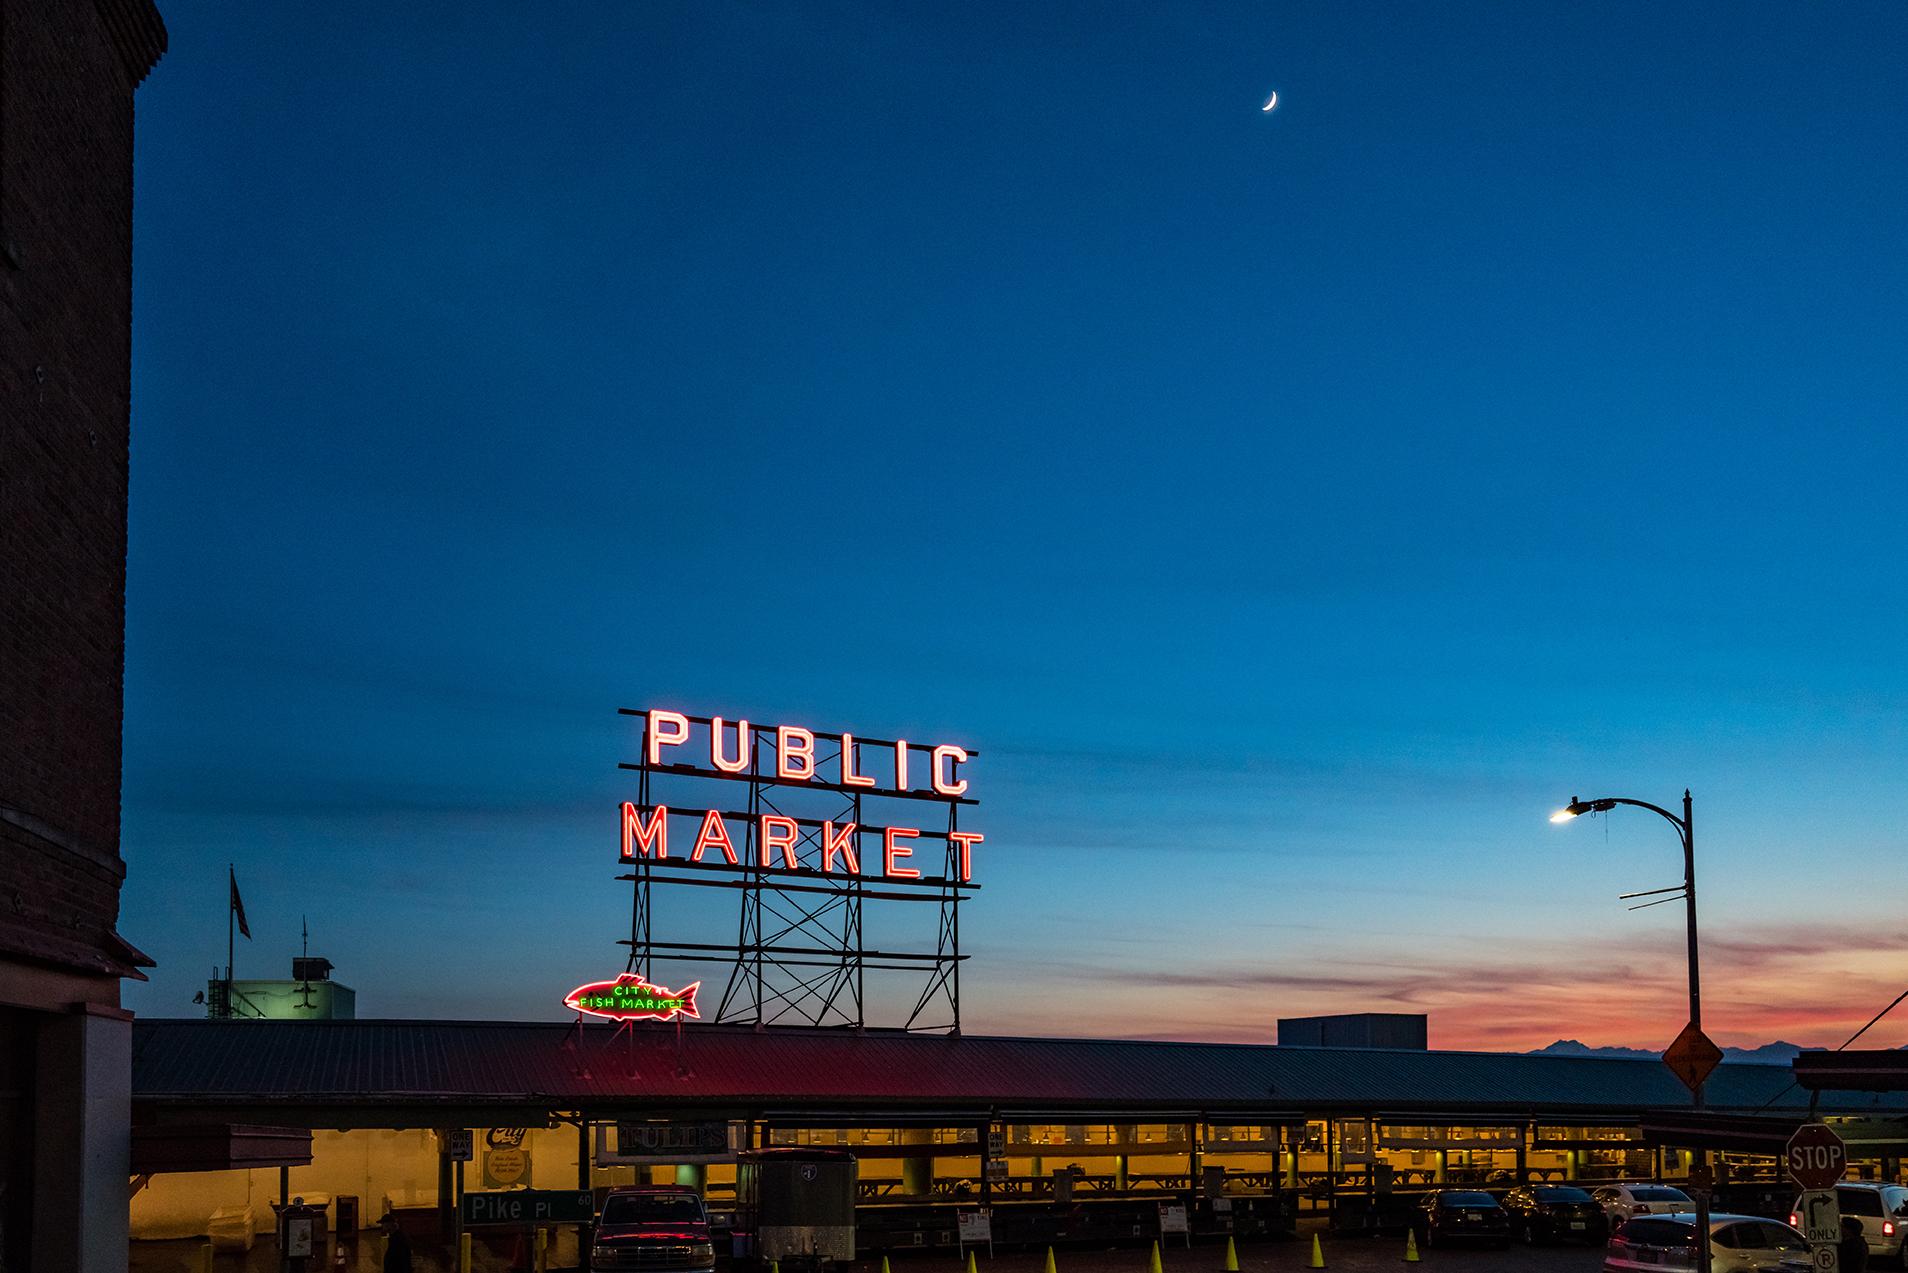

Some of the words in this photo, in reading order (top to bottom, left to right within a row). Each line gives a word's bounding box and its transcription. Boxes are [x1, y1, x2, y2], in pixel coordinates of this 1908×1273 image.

[647, 710, 969, 796] PUBLIC
[620, 801, 985, 883] MARKET
[614, 986, 652, 996] CITY
[579, 997, 614, 1008] FISH
[621, 999, 685, 1009] MARKET
[451, 1133, 470, 1141] ONE
[451, 1141, 470, 1149] WAY
[619, 1123, 727, 1149] TULIPS
[1791, 1145, 1841, 1171] STOP
[471, 1196, 522, 1220] Pike
[535, 1202, 551, 1218] Pl
[577, 1194, 592, 1206] 60
[1809, 1228, 1837, 1241] ONLY
